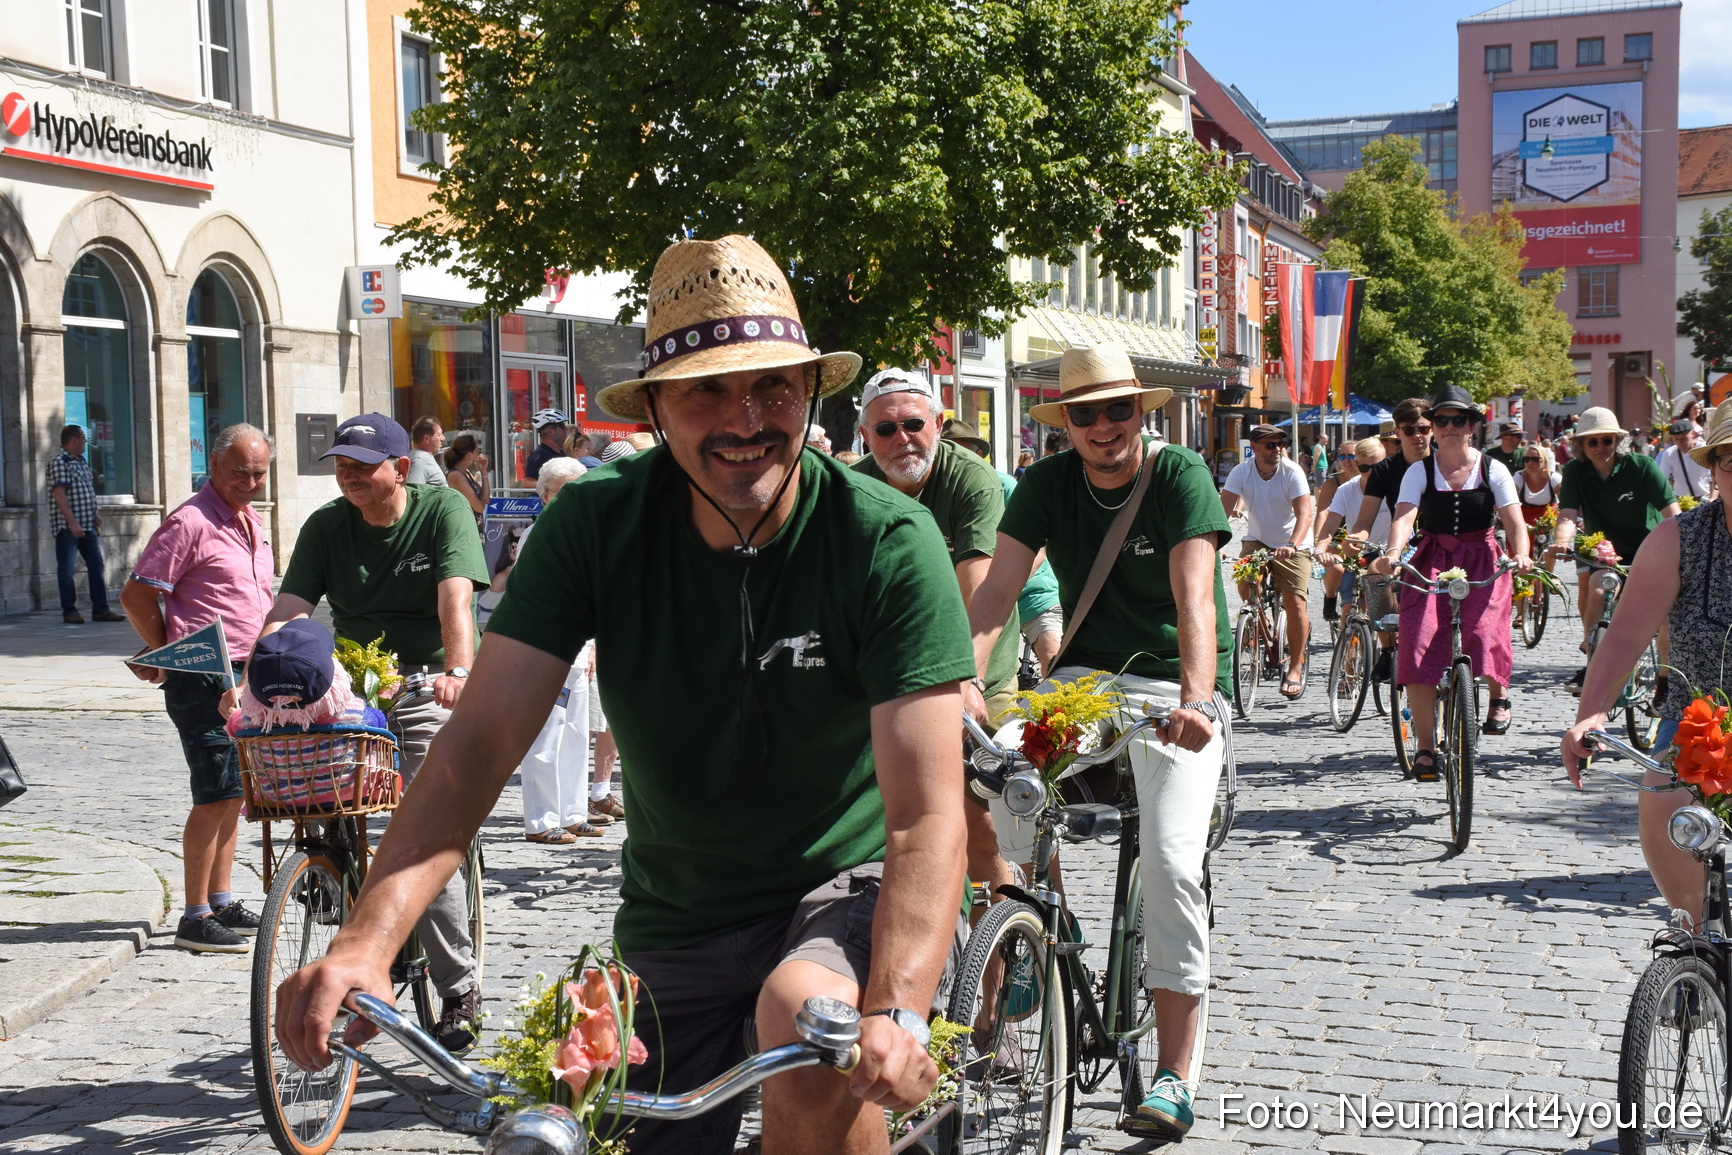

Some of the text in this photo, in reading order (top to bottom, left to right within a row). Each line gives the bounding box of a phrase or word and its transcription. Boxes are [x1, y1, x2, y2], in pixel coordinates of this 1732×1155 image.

[1529, 117, 1551, 128] DIE
[34, 101, 214, 171] HypoVereinsbank
[1522, 219, 1626, 241] sgezeichnet!
[502, 499, 529, 511] Uhren
[174, 652, 217, 667] EXPRESS
